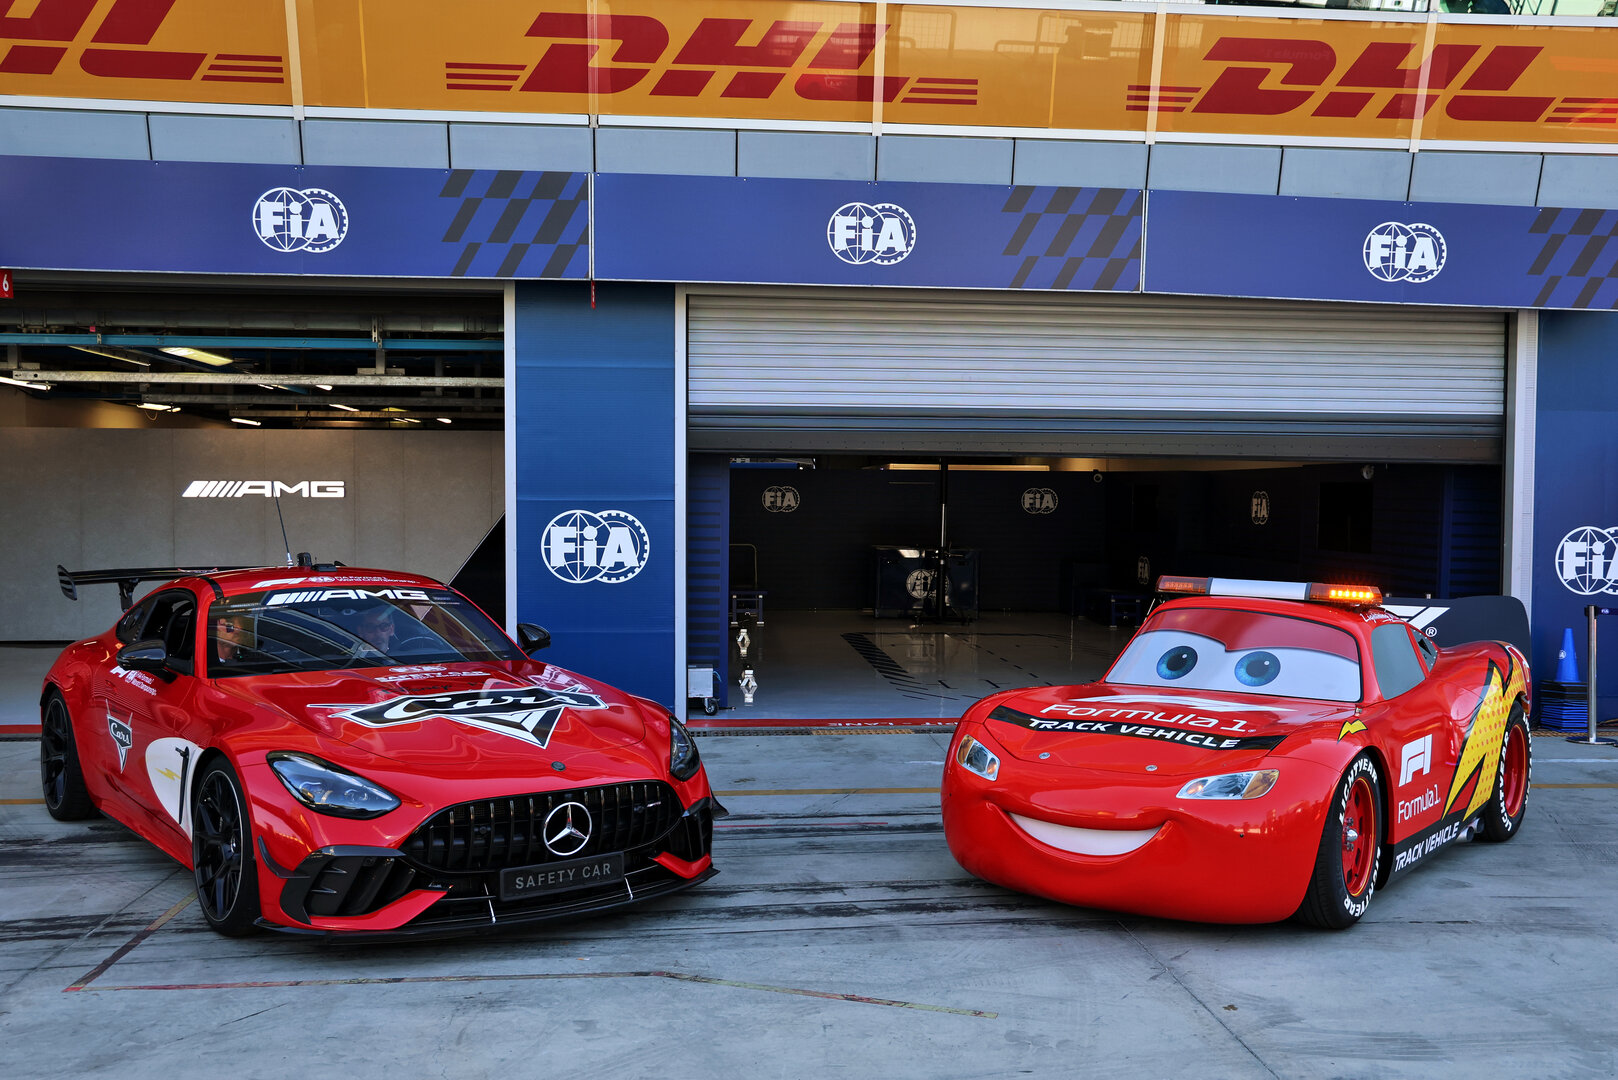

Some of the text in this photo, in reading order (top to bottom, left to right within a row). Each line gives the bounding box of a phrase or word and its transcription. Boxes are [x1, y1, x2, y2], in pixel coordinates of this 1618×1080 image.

[519, 12, 910, 103] DHL
[1191, 37, 1556, 123] DHL
[383, 695, 590, 720] Cars
[1039, 703, 1220, 728] Formula
[110, 722, 131, 745] Cars
[1028, 718, 1241, 749] TRACK VEHICLE
[1338, 757, 1378, 826] LIGHTYEAR
[1397, 788, 1435, 824] Formula
[1394, 821, 1460, 873] TRACK VEHICLE
[515, 862, 611, 890] SAFETY CAR
